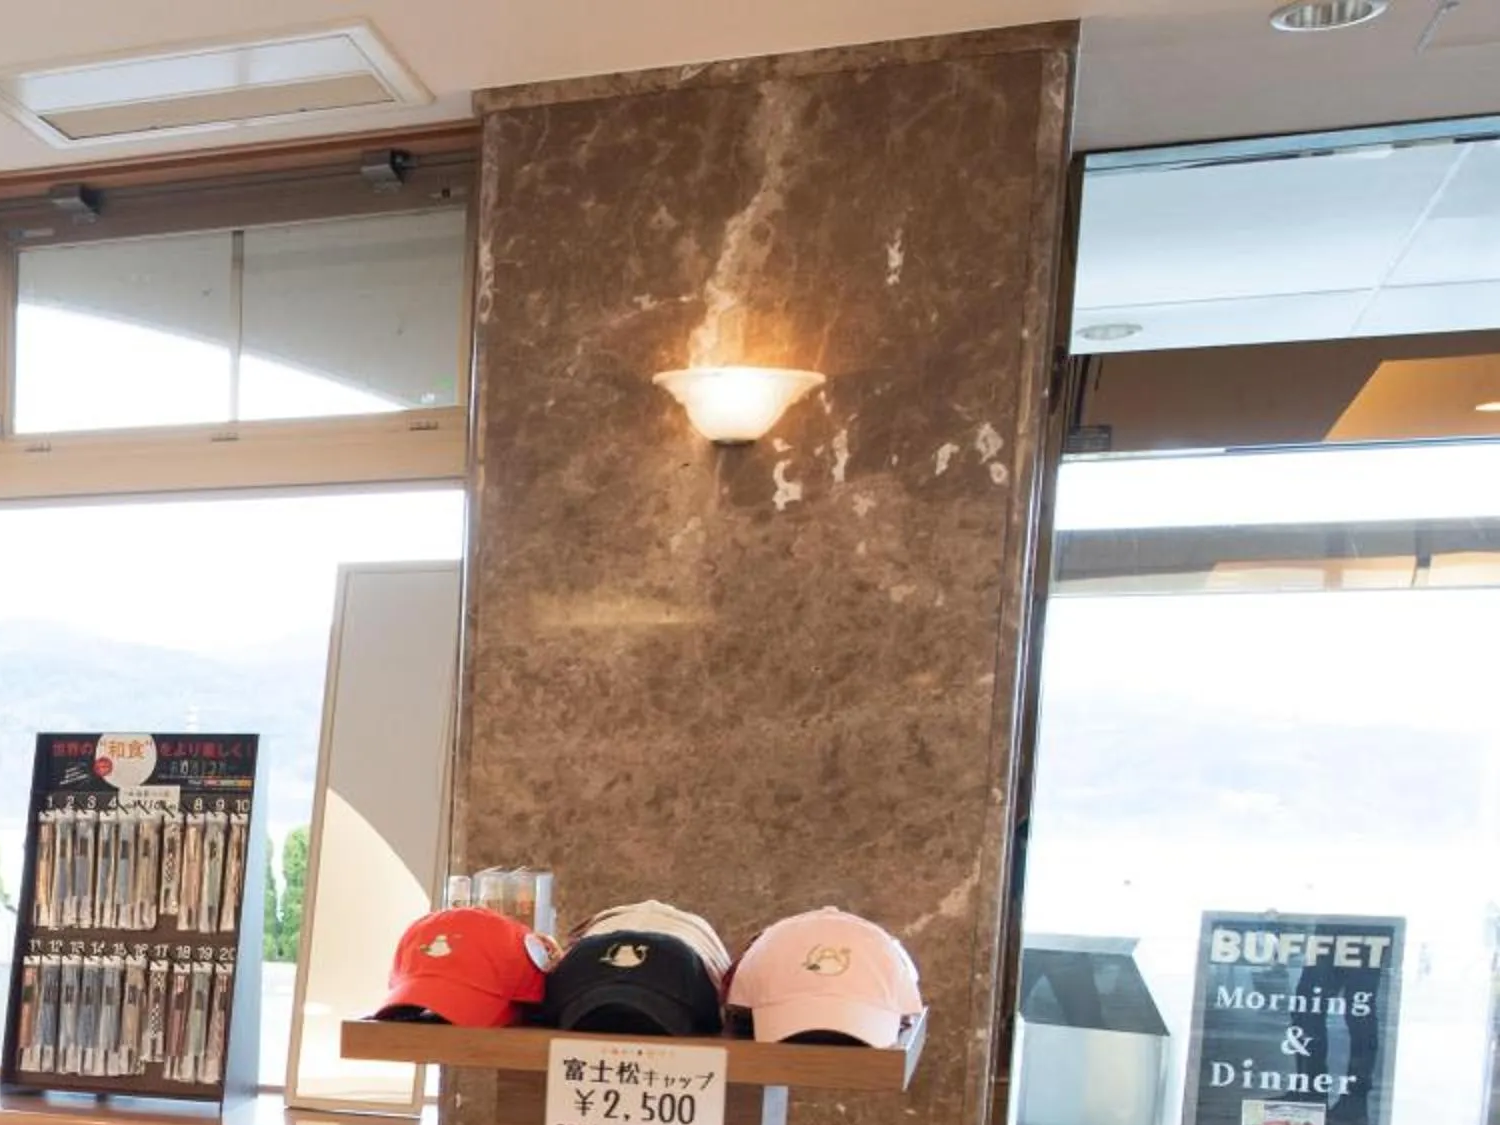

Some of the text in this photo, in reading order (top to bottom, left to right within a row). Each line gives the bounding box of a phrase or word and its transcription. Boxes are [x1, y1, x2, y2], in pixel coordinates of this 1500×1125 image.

[1210, 929, 1391, 968] BUFFET
[1215, 985, 1374, 1017] Morning
[1280, 1025, 1314, 1057] &
[563, 1057, 716, 1091] 富士松キャップ
[1210, 1059, 1358, 1096] Dinner
